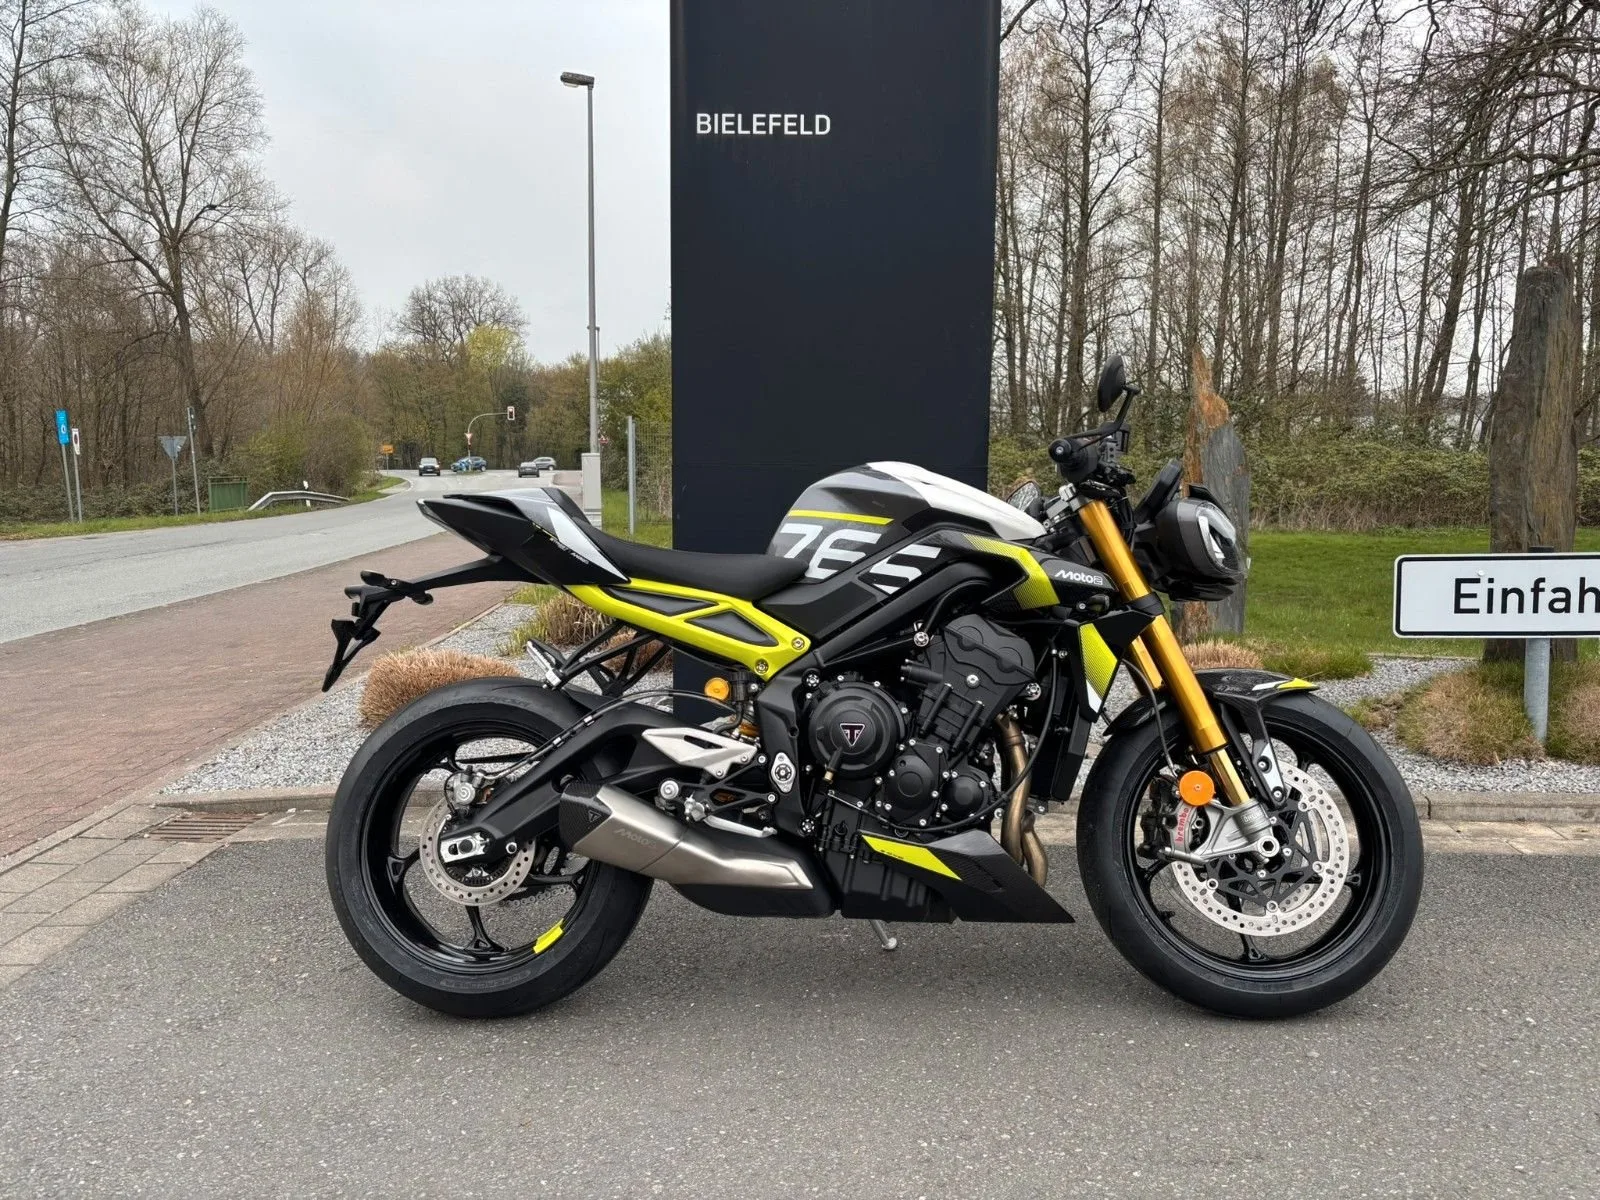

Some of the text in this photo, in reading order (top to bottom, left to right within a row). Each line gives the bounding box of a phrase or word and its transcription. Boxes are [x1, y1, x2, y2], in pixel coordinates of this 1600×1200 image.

[696, 112, 832, 136] BIELEFELD
[1054, 569, 1104, 586] Moto2
[1453, 576, 1600, 615] Einfah
[1175, 806, 1190, 843] brembo
